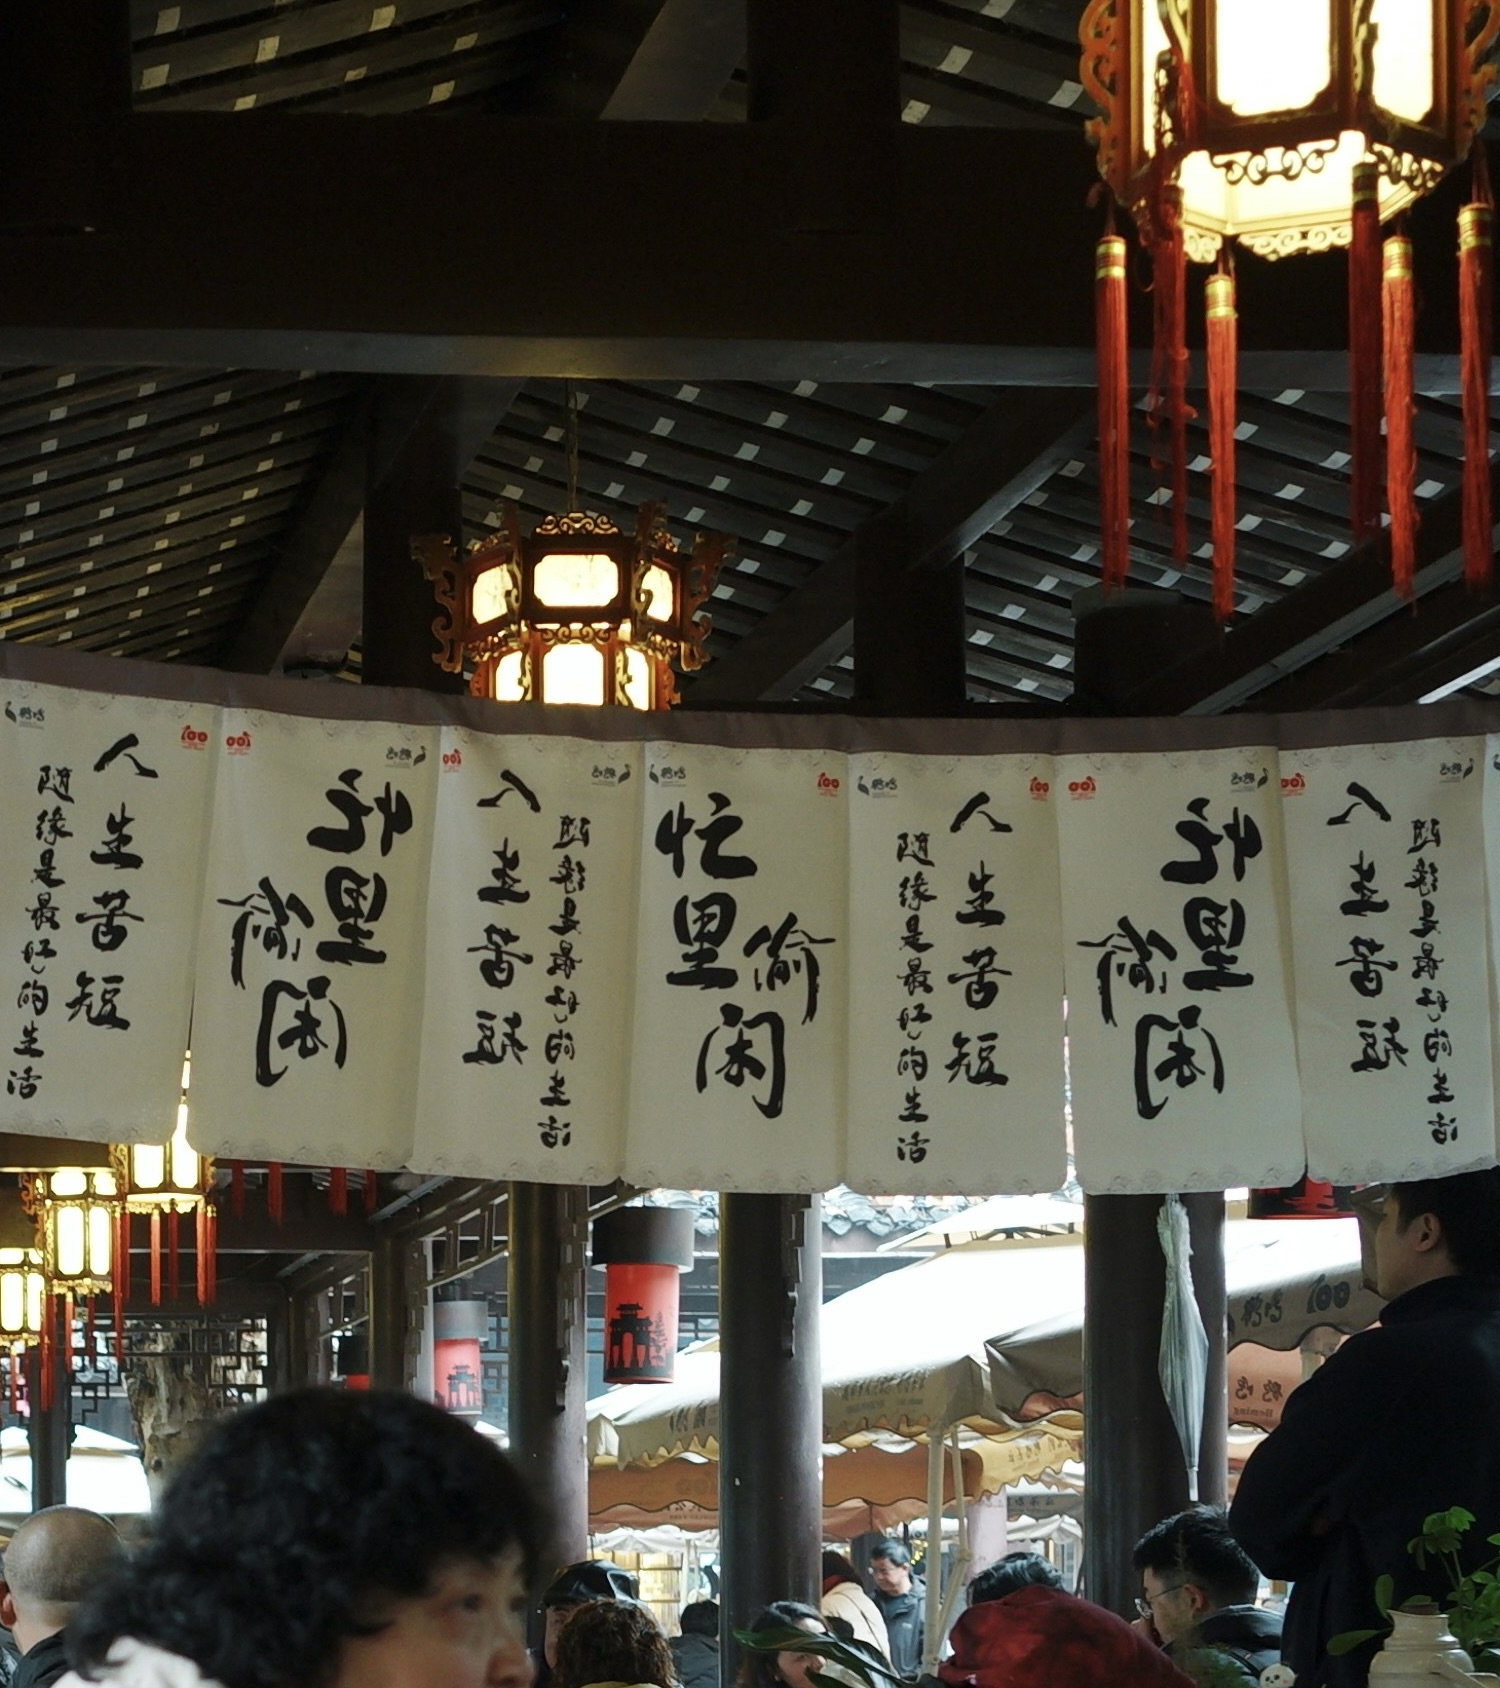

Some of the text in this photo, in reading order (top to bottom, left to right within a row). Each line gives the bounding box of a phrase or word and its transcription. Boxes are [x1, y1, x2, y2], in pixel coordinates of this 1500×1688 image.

[6, 766, 74, 1099] 随缘是最好的生活
[66, 734, 158, 1030] 人生苦短
[656, 792, 836, 1119] 忙里偷闲
[896, 832, 935, 1164] 随缘是最好的生活
[944, 792, 1012, 1086] 人生苦短
